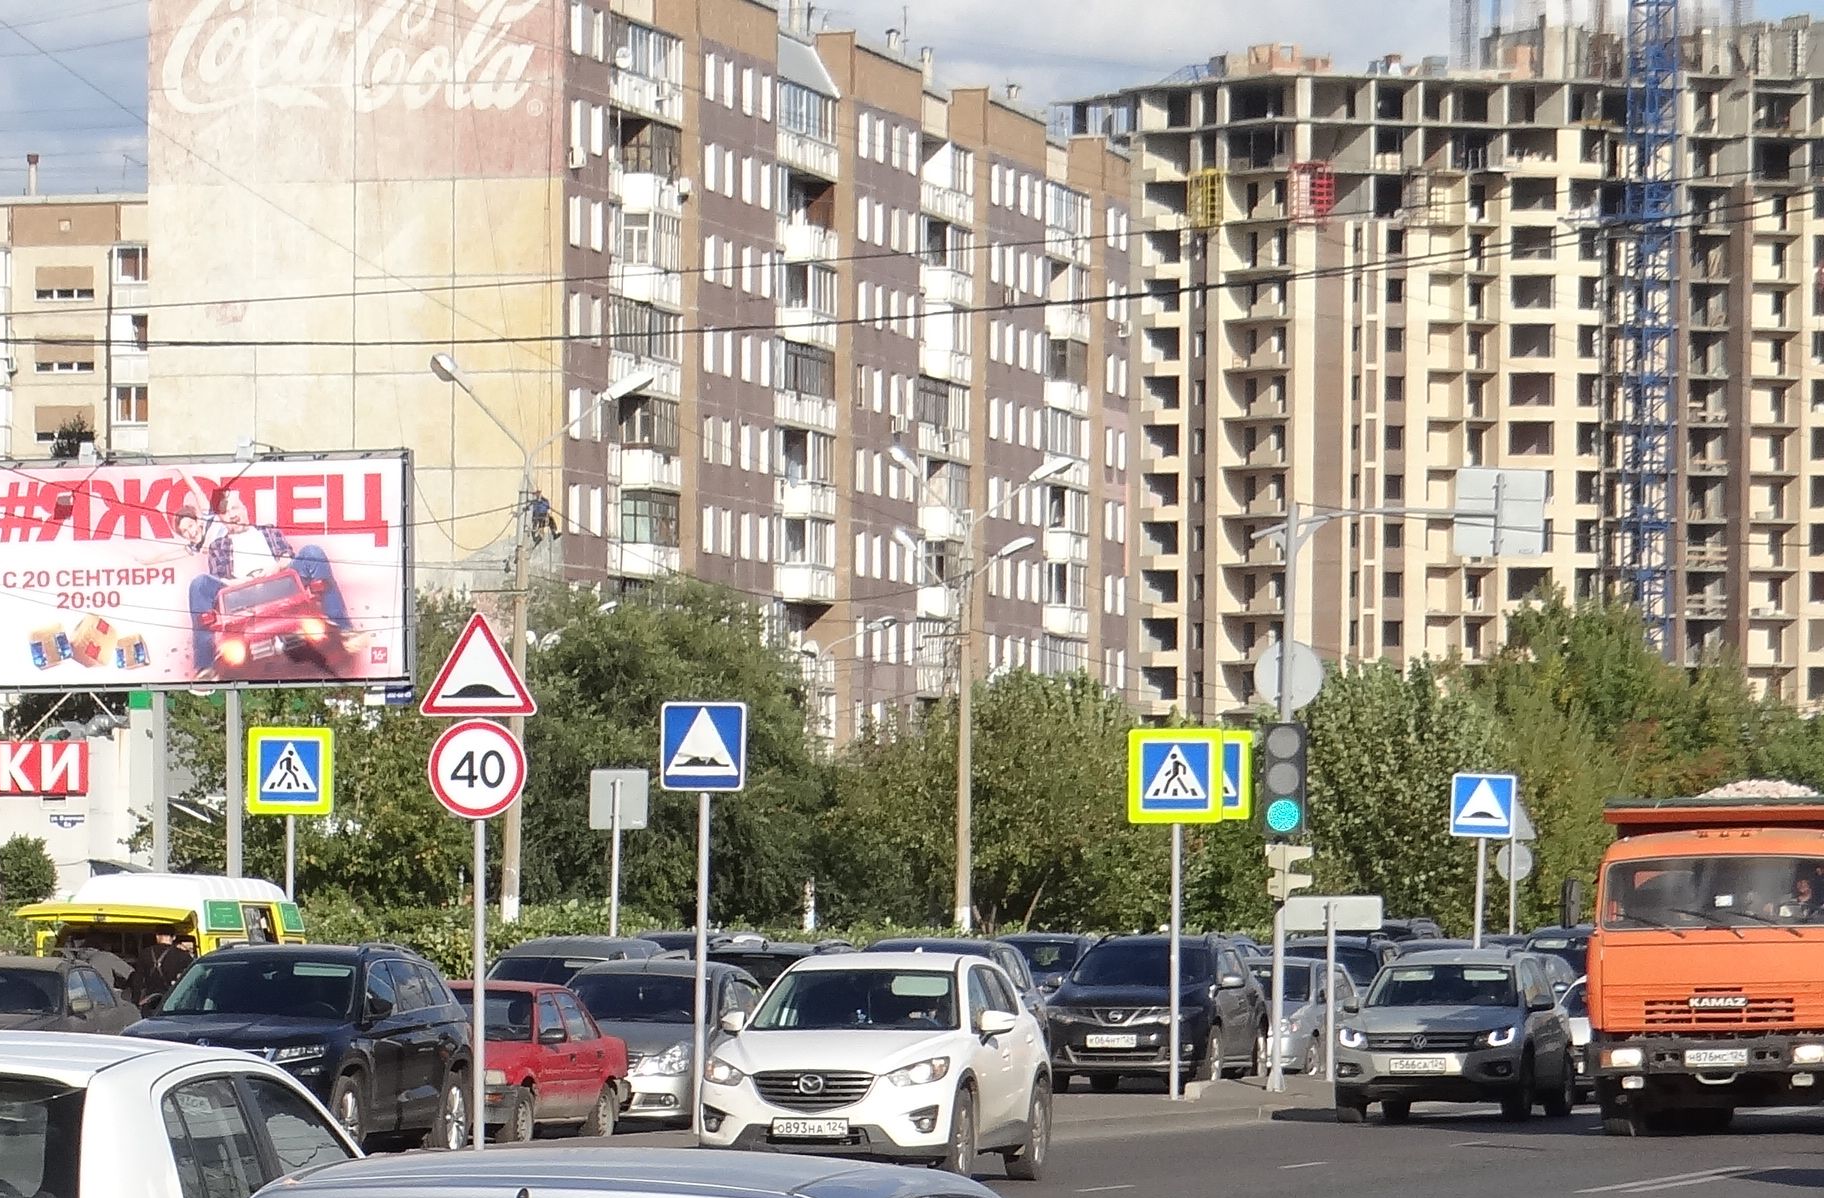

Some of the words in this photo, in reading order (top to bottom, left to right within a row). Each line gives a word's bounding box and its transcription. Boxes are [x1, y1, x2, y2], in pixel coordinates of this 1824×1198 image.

[3, 572, 18, 589] С
[23, 571, 51, 589] 20
[56, 567, 176, 588] СЕНТЯБРЯ
[57, 591, 121, 609] 20:00
[450, 750, 505, 788] 40
[1689, 997, 1747, 1007] KAMAZ
[777, 1122, 823, 1134] О893НА
